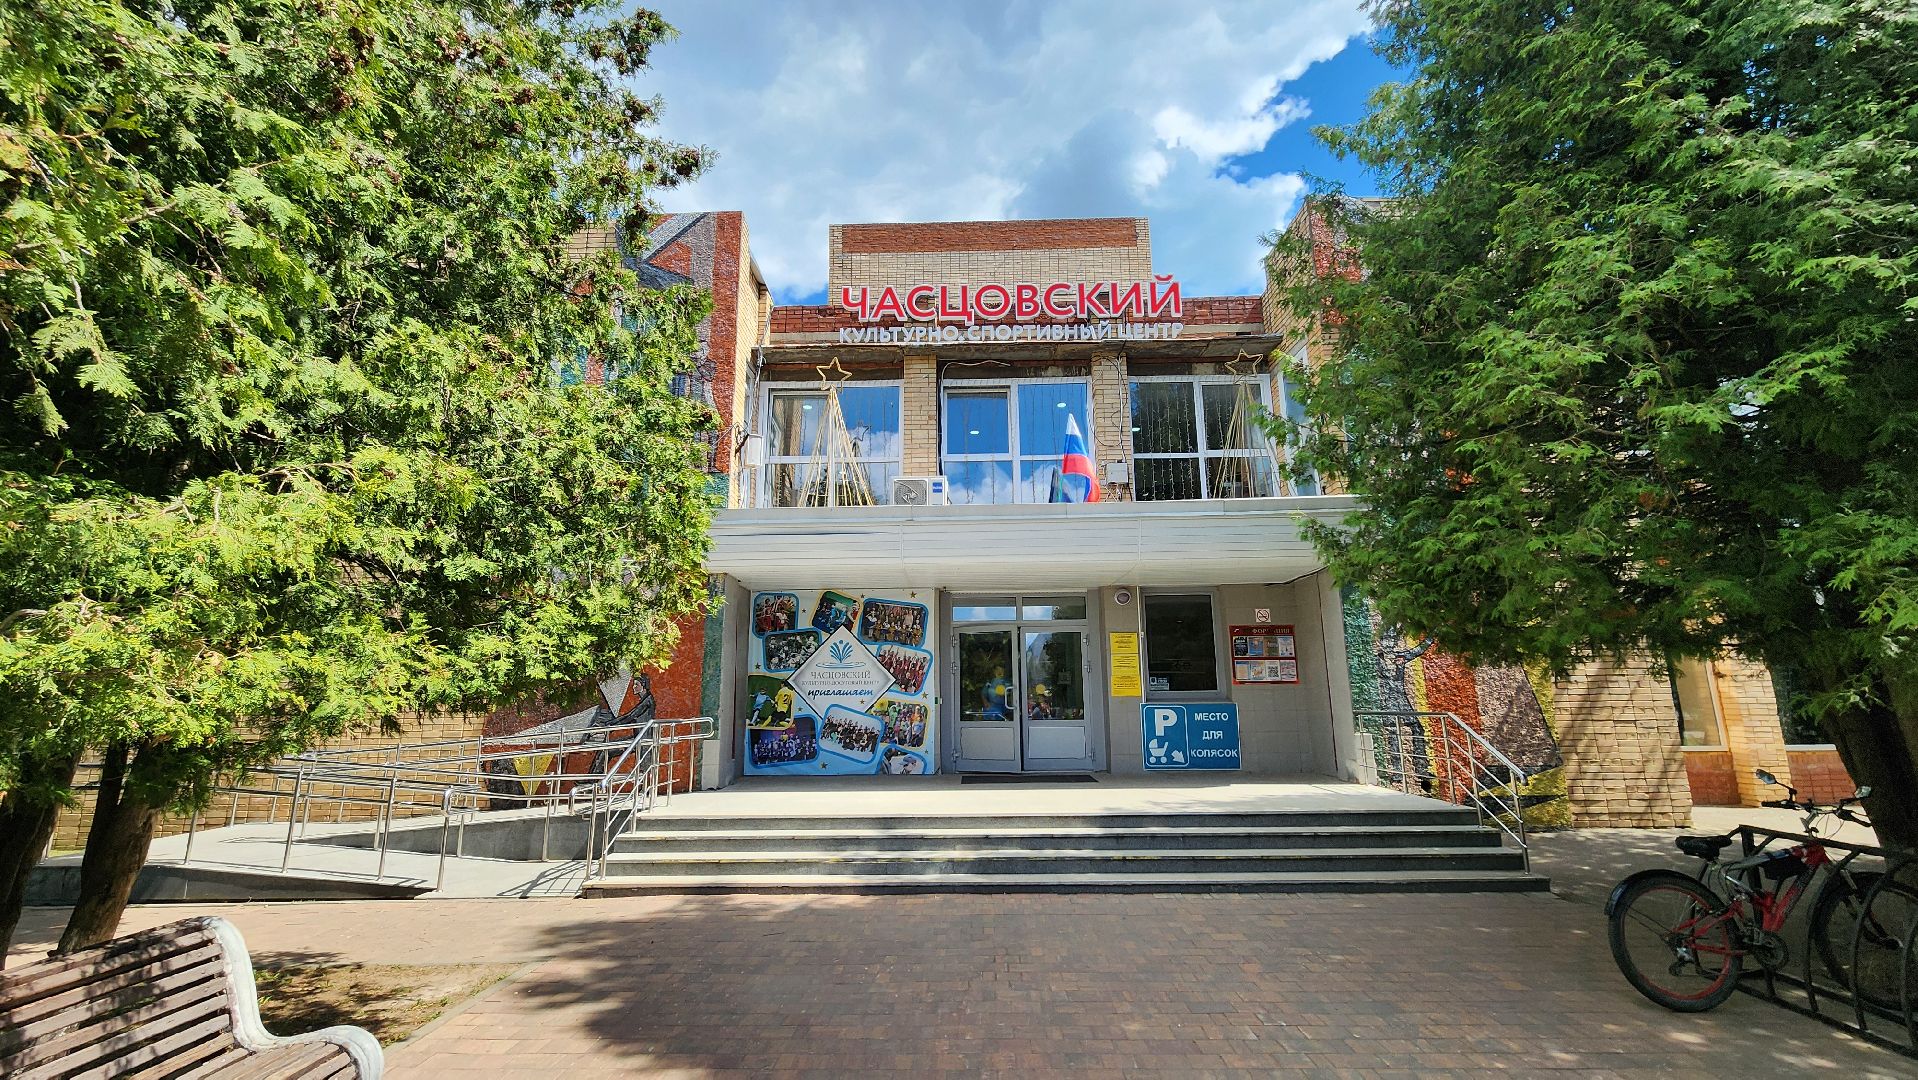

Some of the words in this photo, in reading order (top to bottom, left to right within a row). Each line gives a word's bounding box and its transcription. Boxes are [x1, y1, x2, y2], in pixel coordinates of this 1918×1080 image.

[842, 274, 1183, 326] ЧАСЦОВСКИЙ
[1117, 322, 1184, 341] ЦЕНТР
[810, 670, 871, 680] ЧАСЦОВСКИЙ
[807, 689, 873, 700] приглашает
[1154, 708, 1178, 736] P
[1194, 712, 1229, 721] МЕСТО
[1202, 730, 1223, 741] ДЛЯ
[1190, 748, 1239, 759] КОЛЯСОК
